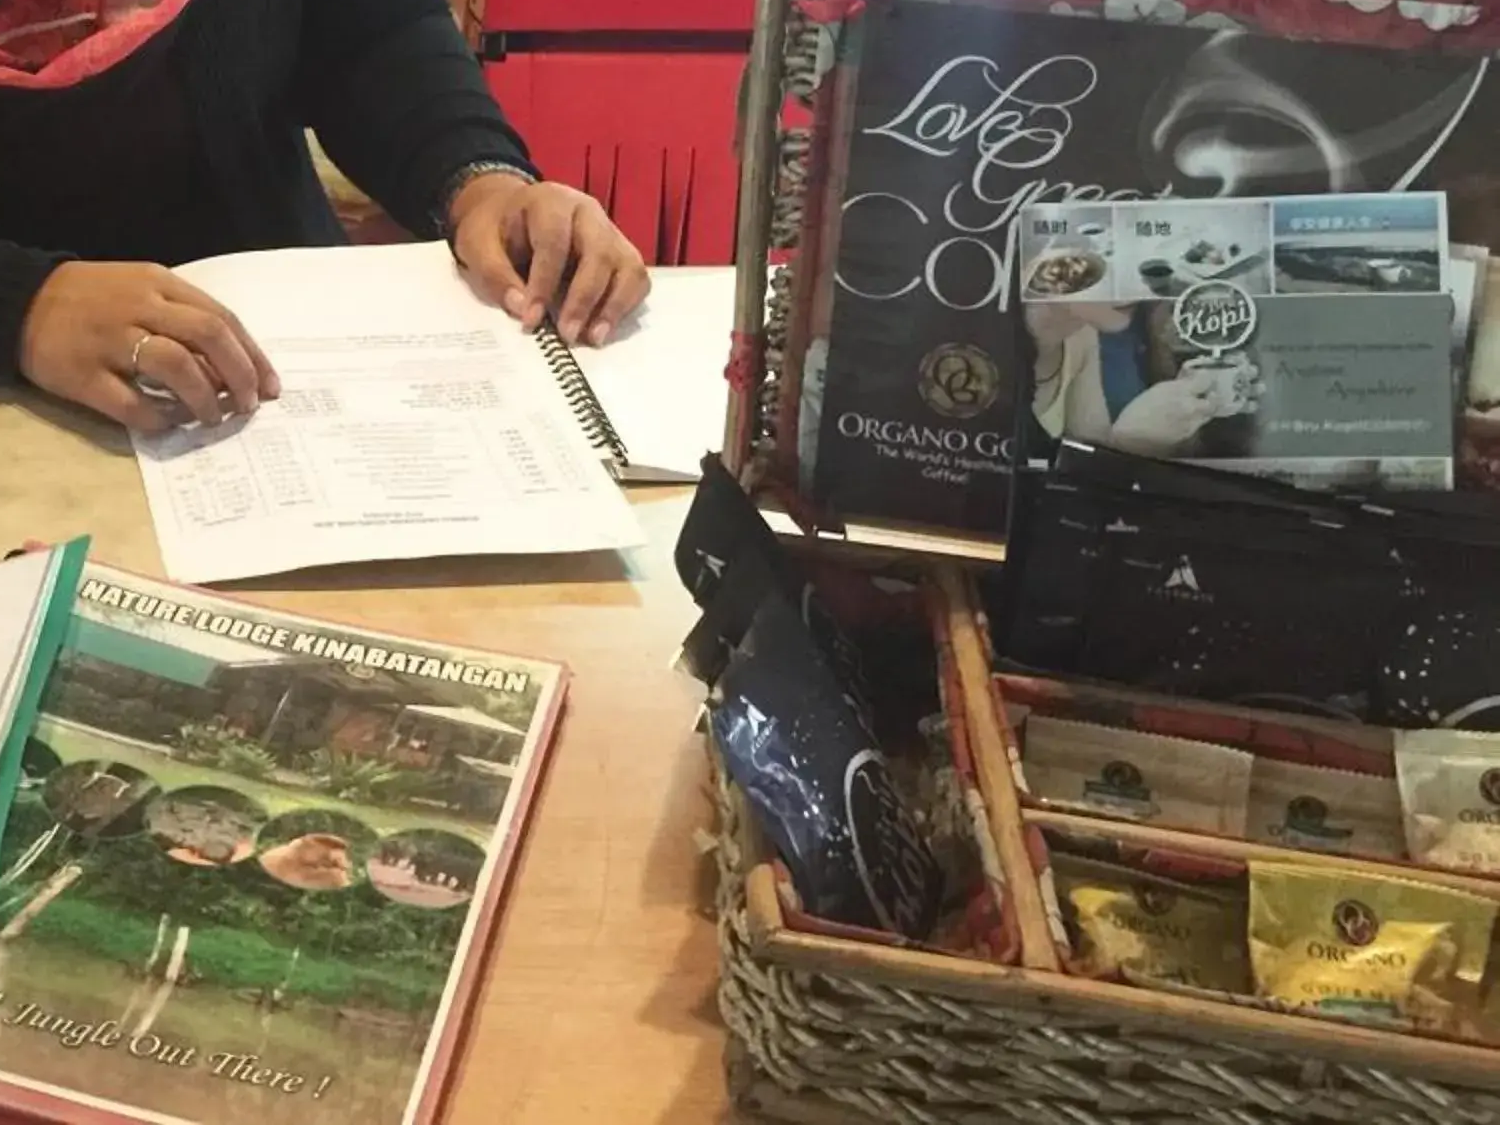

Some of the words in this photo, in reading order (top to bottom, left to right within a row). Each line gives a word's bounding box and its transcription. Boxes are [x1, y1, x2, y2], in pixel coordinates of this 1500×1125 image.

[1178, 299, 1251, 338] Kopi
[838, 412, 969, 452] ORGANO
[80, 579, 200, 631] NATURE
[194, 610, 292, 650] LODGE
[293, 632, 530, 693] KINABATANGAN
[2, 1001, 123, 1048] Jungle
[128, 1031, 200, 1068] Out
[207, 1051, 305, 1094] There
